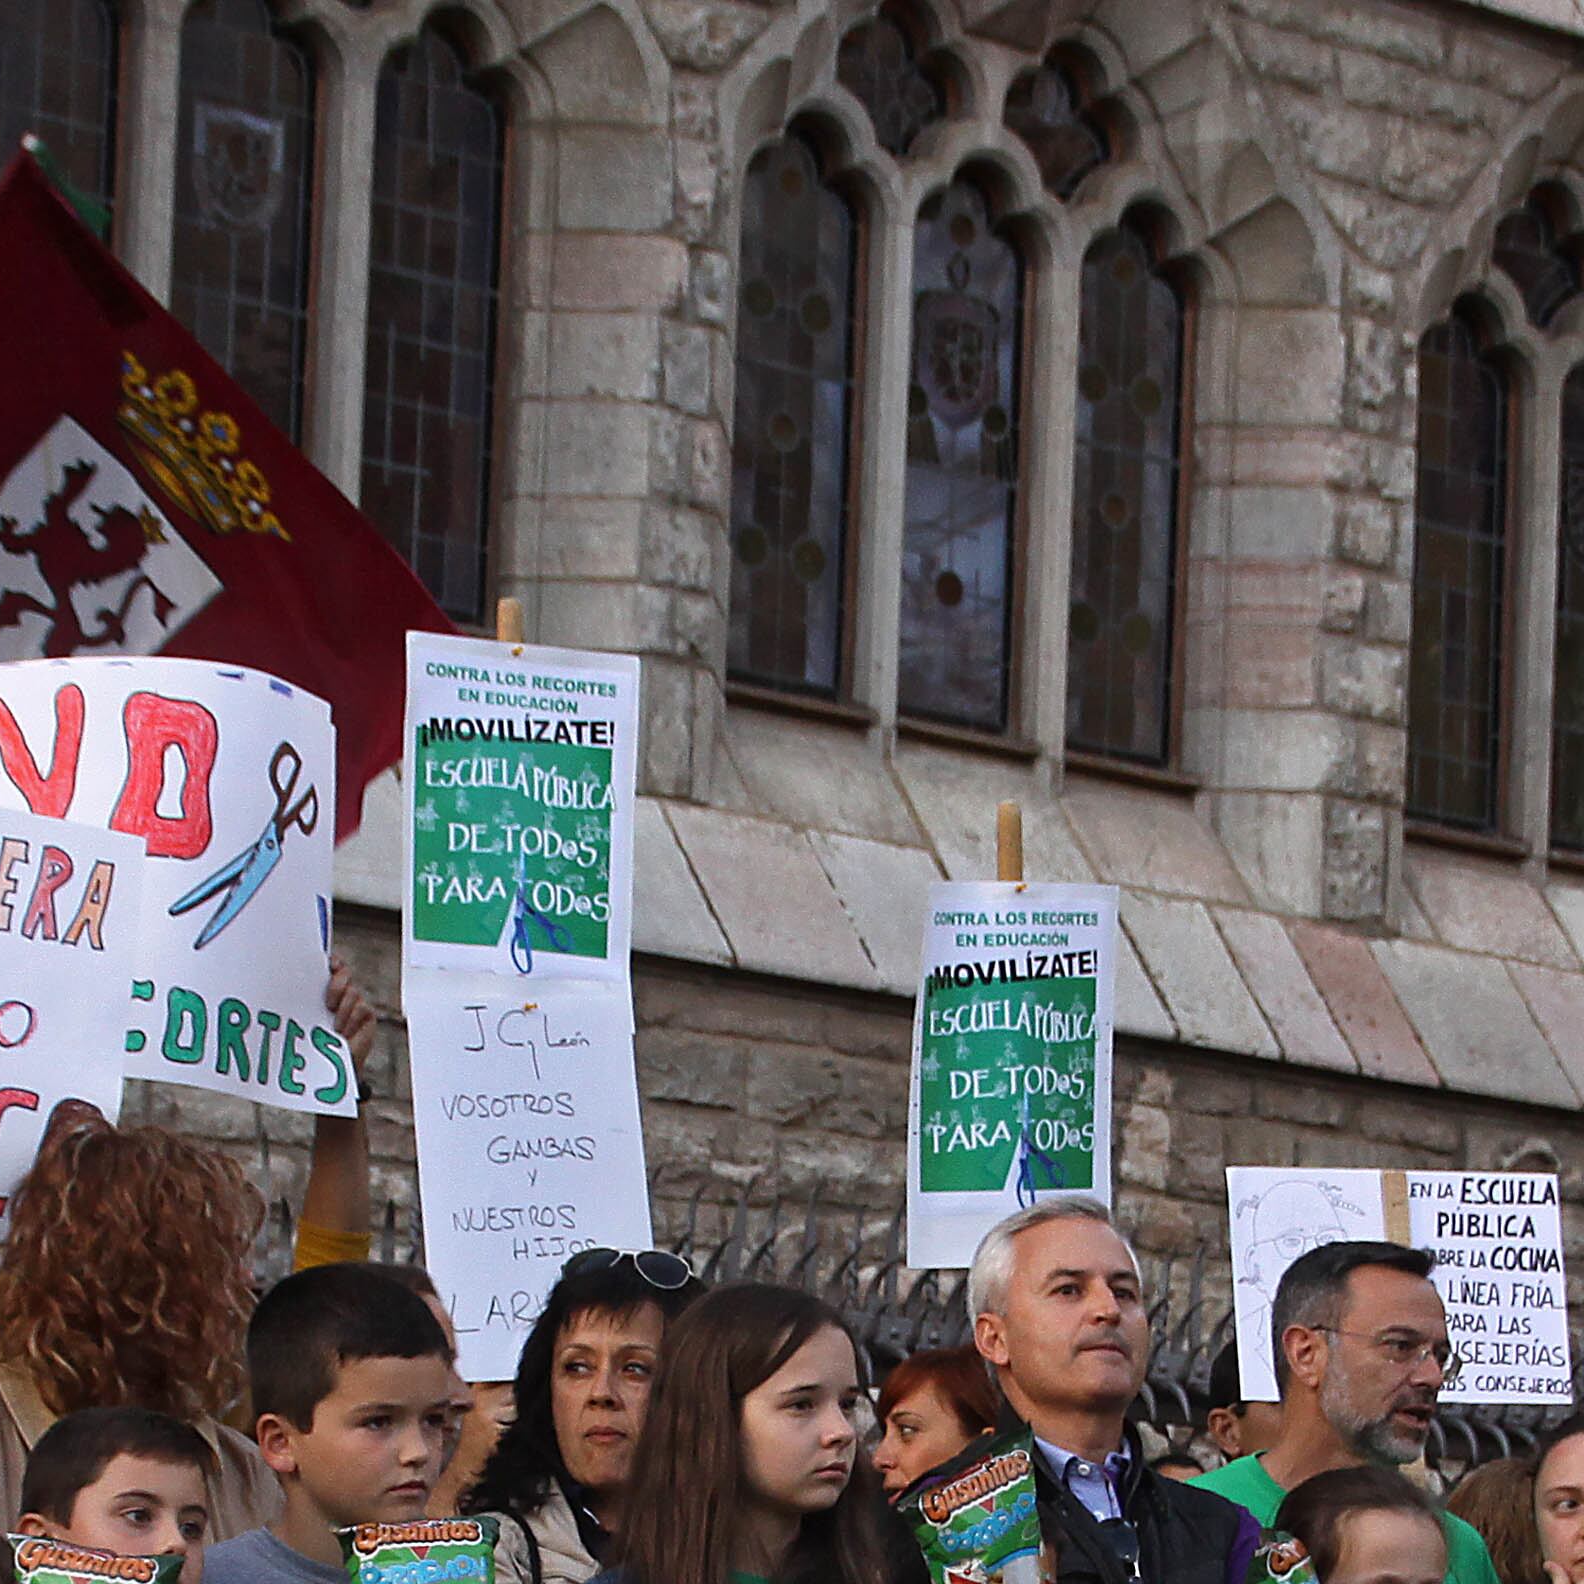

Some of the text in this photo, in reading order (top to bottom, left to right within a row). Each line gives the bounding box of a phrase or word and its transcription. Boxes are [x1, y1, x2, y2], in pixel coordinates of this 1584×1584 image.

[426, 661, 617, 698] CONTRA LOS RECORTES
[458, 688, 578, 714] EN EDUCACIÓN
[422, 713, 615, 748] ¡MOVILÍZATE!
[426, 758, 616, 813] ESCUELA PÚBLICA
[448, 822, 491, 853] DE
[426, 873, 507, 904] PARA
[934, 911, 1098, 926] CONTRA LOS RECORTES
[956, 930, 1069, 947] EN EDUCACIÓN
[928, 949, 1098, 997] ¡MOVILÍZATE!
[929, 1000, 1098, 1043] ESCUELA PÚBLICA
[950, 1068, 996, 1099] DE
[441, 1093, 576, 1120] VOSOTROS
[486, 1136, 597, 1164] GAMBAS
[931, 1122, 1012, 1153] PARA
[1409, 1177, 1557, 1206] EN LA ESCUELA
[452, 1205, 577, 1233] NUESTROS
[1436, 1206, 1536, 1238] PÚBLICA
[1470, 1250, 1486, 1267] LA
[1490, 1246, 1561, 1273] COCINA
[1448, 1275, 1500, 1306] LÍNEA
[1498, 1315, 1531, 1335] LAS
[1475, 1375, 1572, 1395] CONSEJEROS
